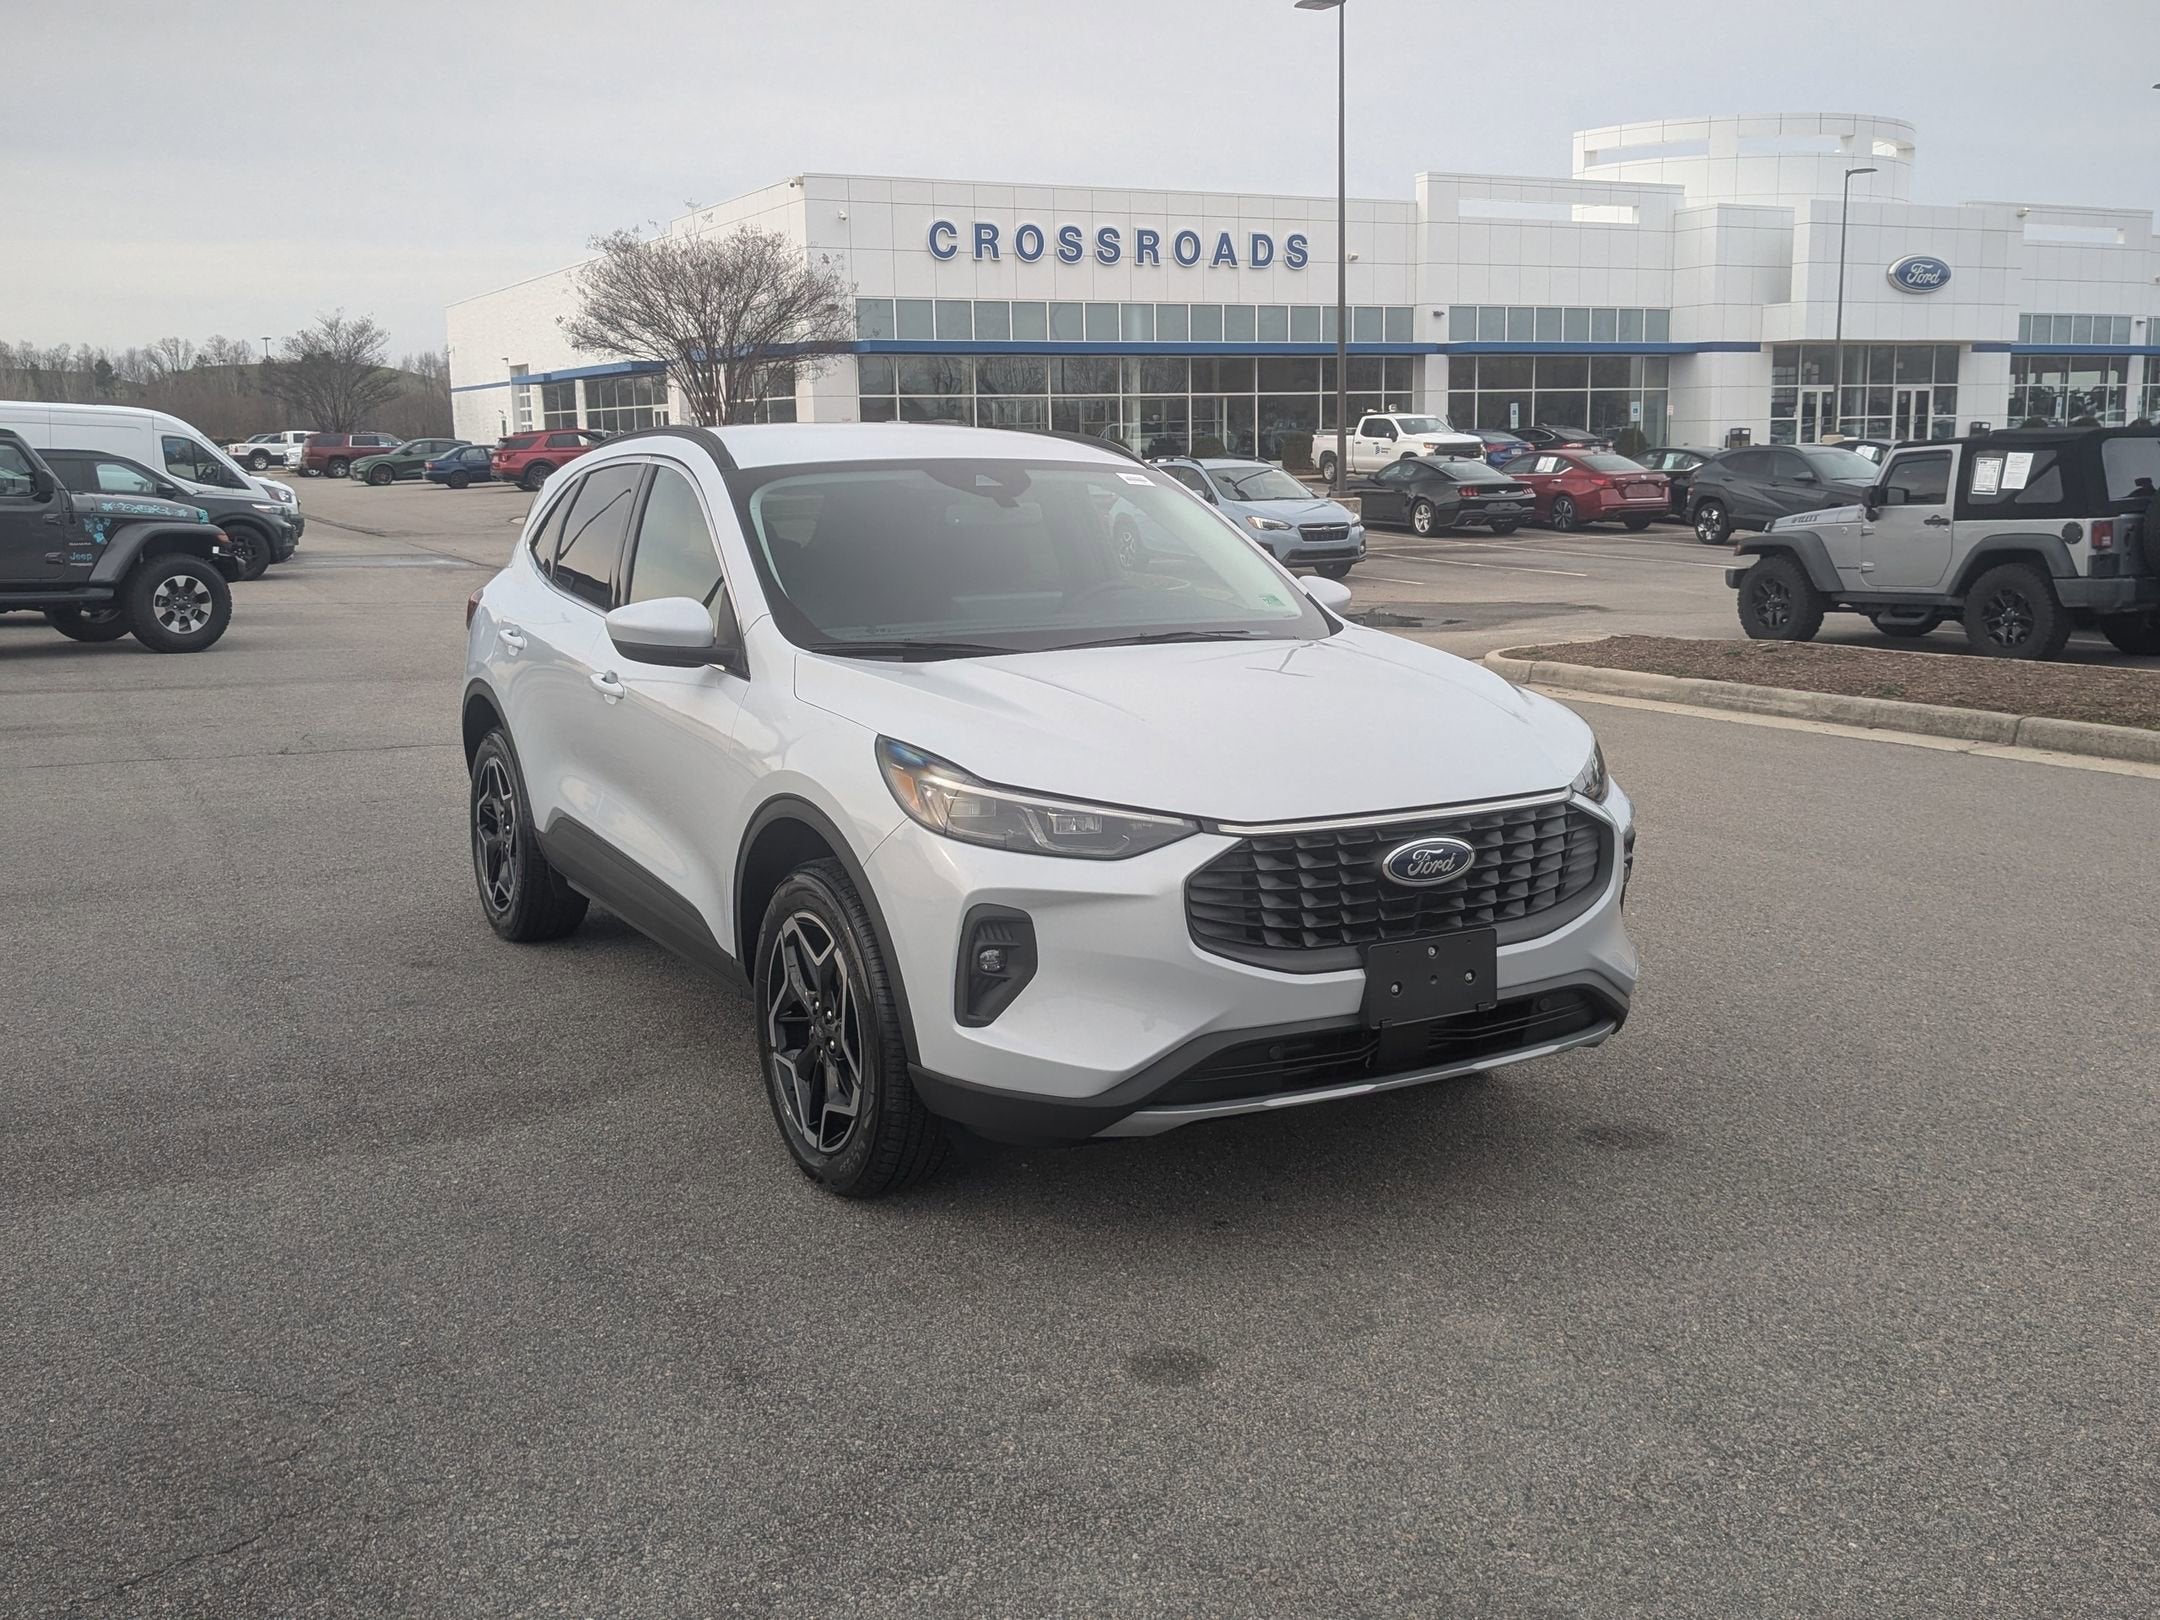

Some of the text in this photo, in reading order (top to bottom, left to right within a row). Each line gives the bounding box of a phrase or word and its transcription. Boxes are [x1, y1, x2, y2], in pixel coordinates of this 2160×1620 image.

[928, 220, 1309, 270] CROSSROADS
[1906, 262, 1942, 284] Ford
[69, 551, 93, 561] Jeep
[1408, 848, 1457, 876] Ford
